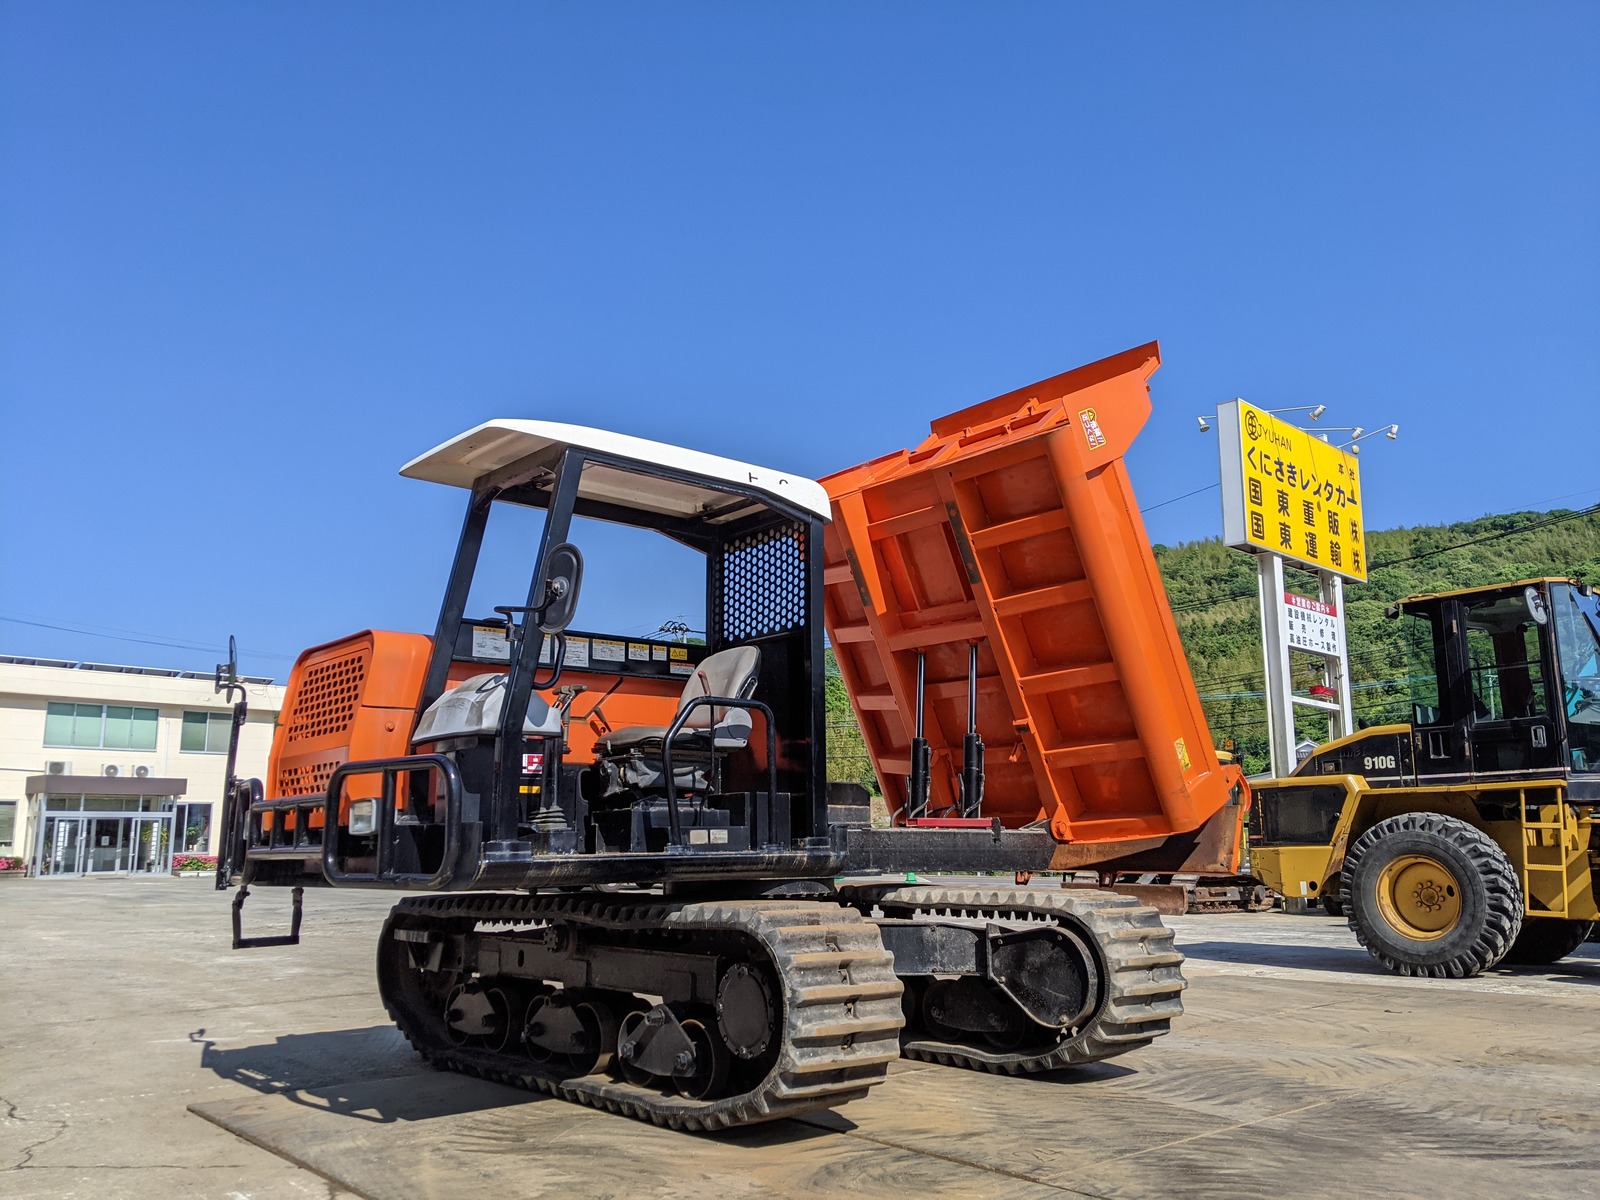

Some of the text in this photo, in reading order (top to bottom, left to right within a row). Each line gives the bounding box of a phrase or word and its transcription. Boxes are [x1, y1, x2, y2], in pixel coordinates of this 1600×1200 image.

[1247, 446, 1357, 508] くにさきレンタカー
[1364, 755, 1396, 770] 910G
